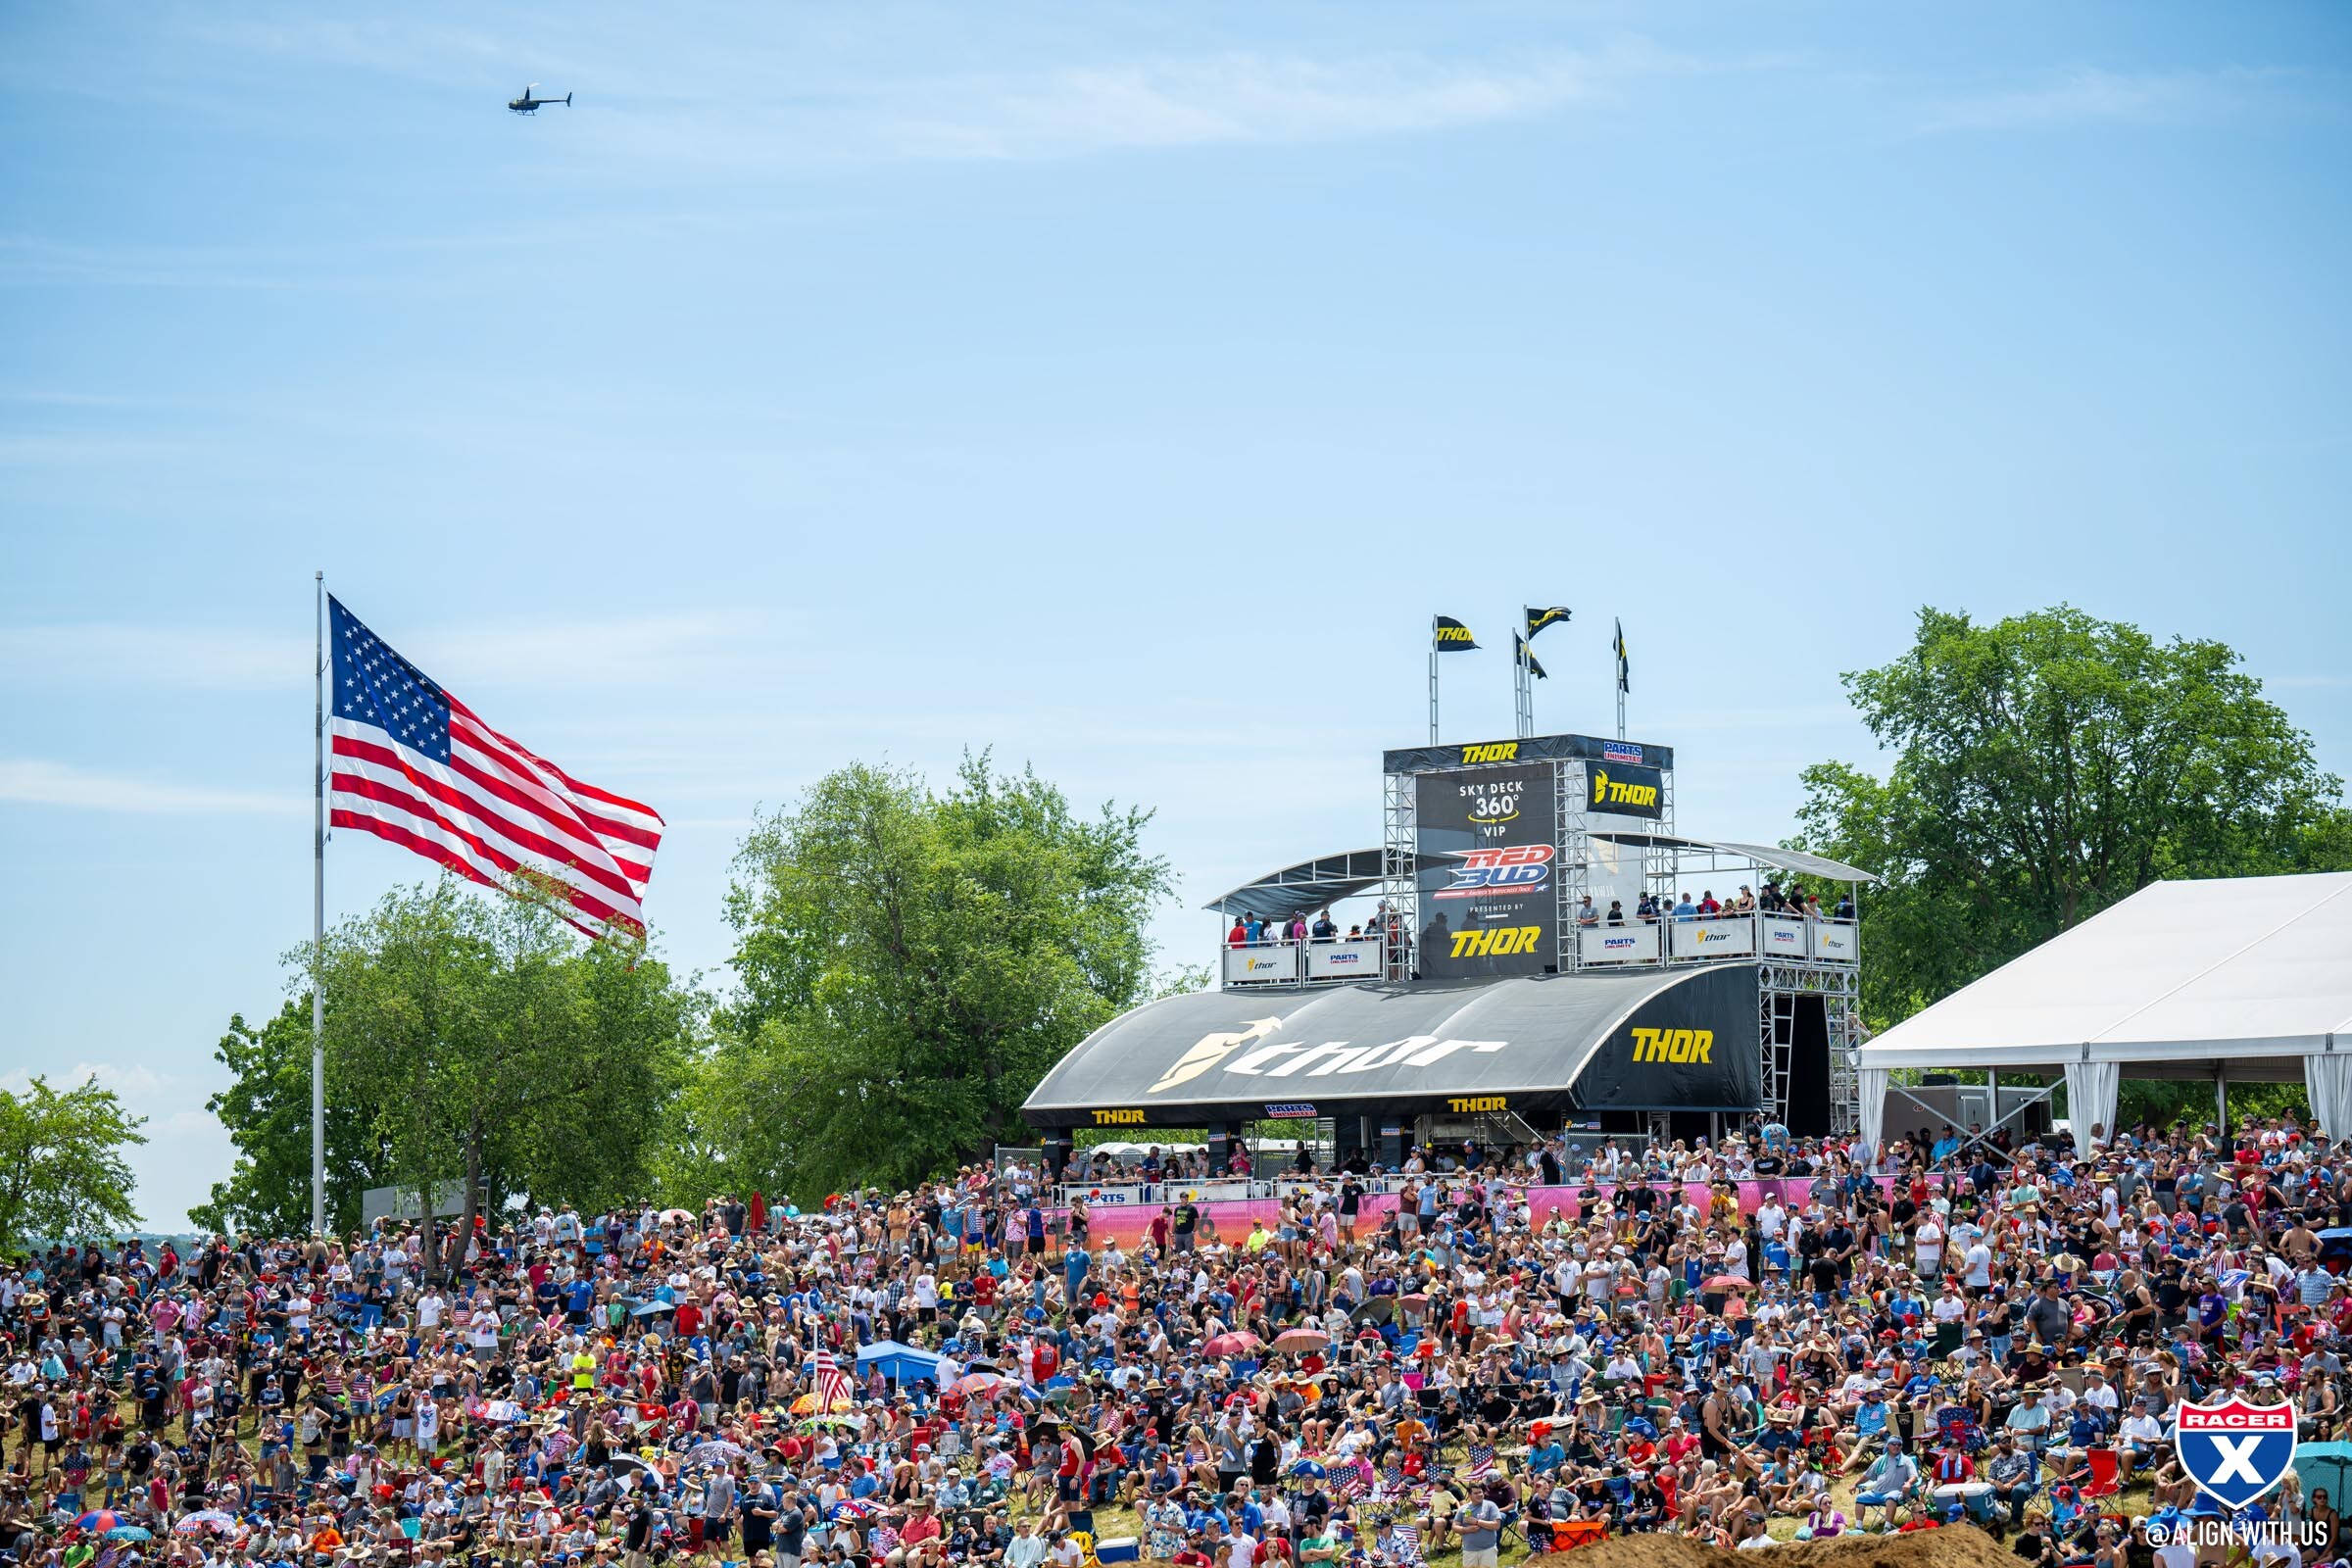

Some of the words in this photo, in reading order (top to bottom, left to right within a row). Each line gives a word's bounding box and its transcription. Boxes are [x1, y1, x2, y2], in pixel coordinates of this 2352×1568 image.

[1461, 742, 1518, 763] THOR
[1604, 742, 1642, 757] PARTS
[1604, 752, 1642, 762] UNLIMITED
[1459, 784, 1484, 797] SKY
[1491, 781, 1524, 794] DECK
[1608, 780, 1657, 808] THOR
[1484, 826, 1505, 837] VIP
[1441, 844, 1554, 868] RED
[1440, 863, 1548, 889] BUD
[1470, 904, 1511, 912] PRESENTED
[1450, 925, 1542, 957] THOR
[1705, 932, 1731, 942] thor
[1254, 961, 1277, 970] thor
[1631, 1027, 1714, 1064] THOR
[1223, 1035, 1510, 1077] thor
[1266, 1103, 1314, 1112] PARTS
[1447, 1097, 1507, 1112] THOR
[1092, 1109, 1146, 1124] THOR
[1199, 1206, 1214, 1239] 6
[1781, 1400, 1795, 1410] USA
